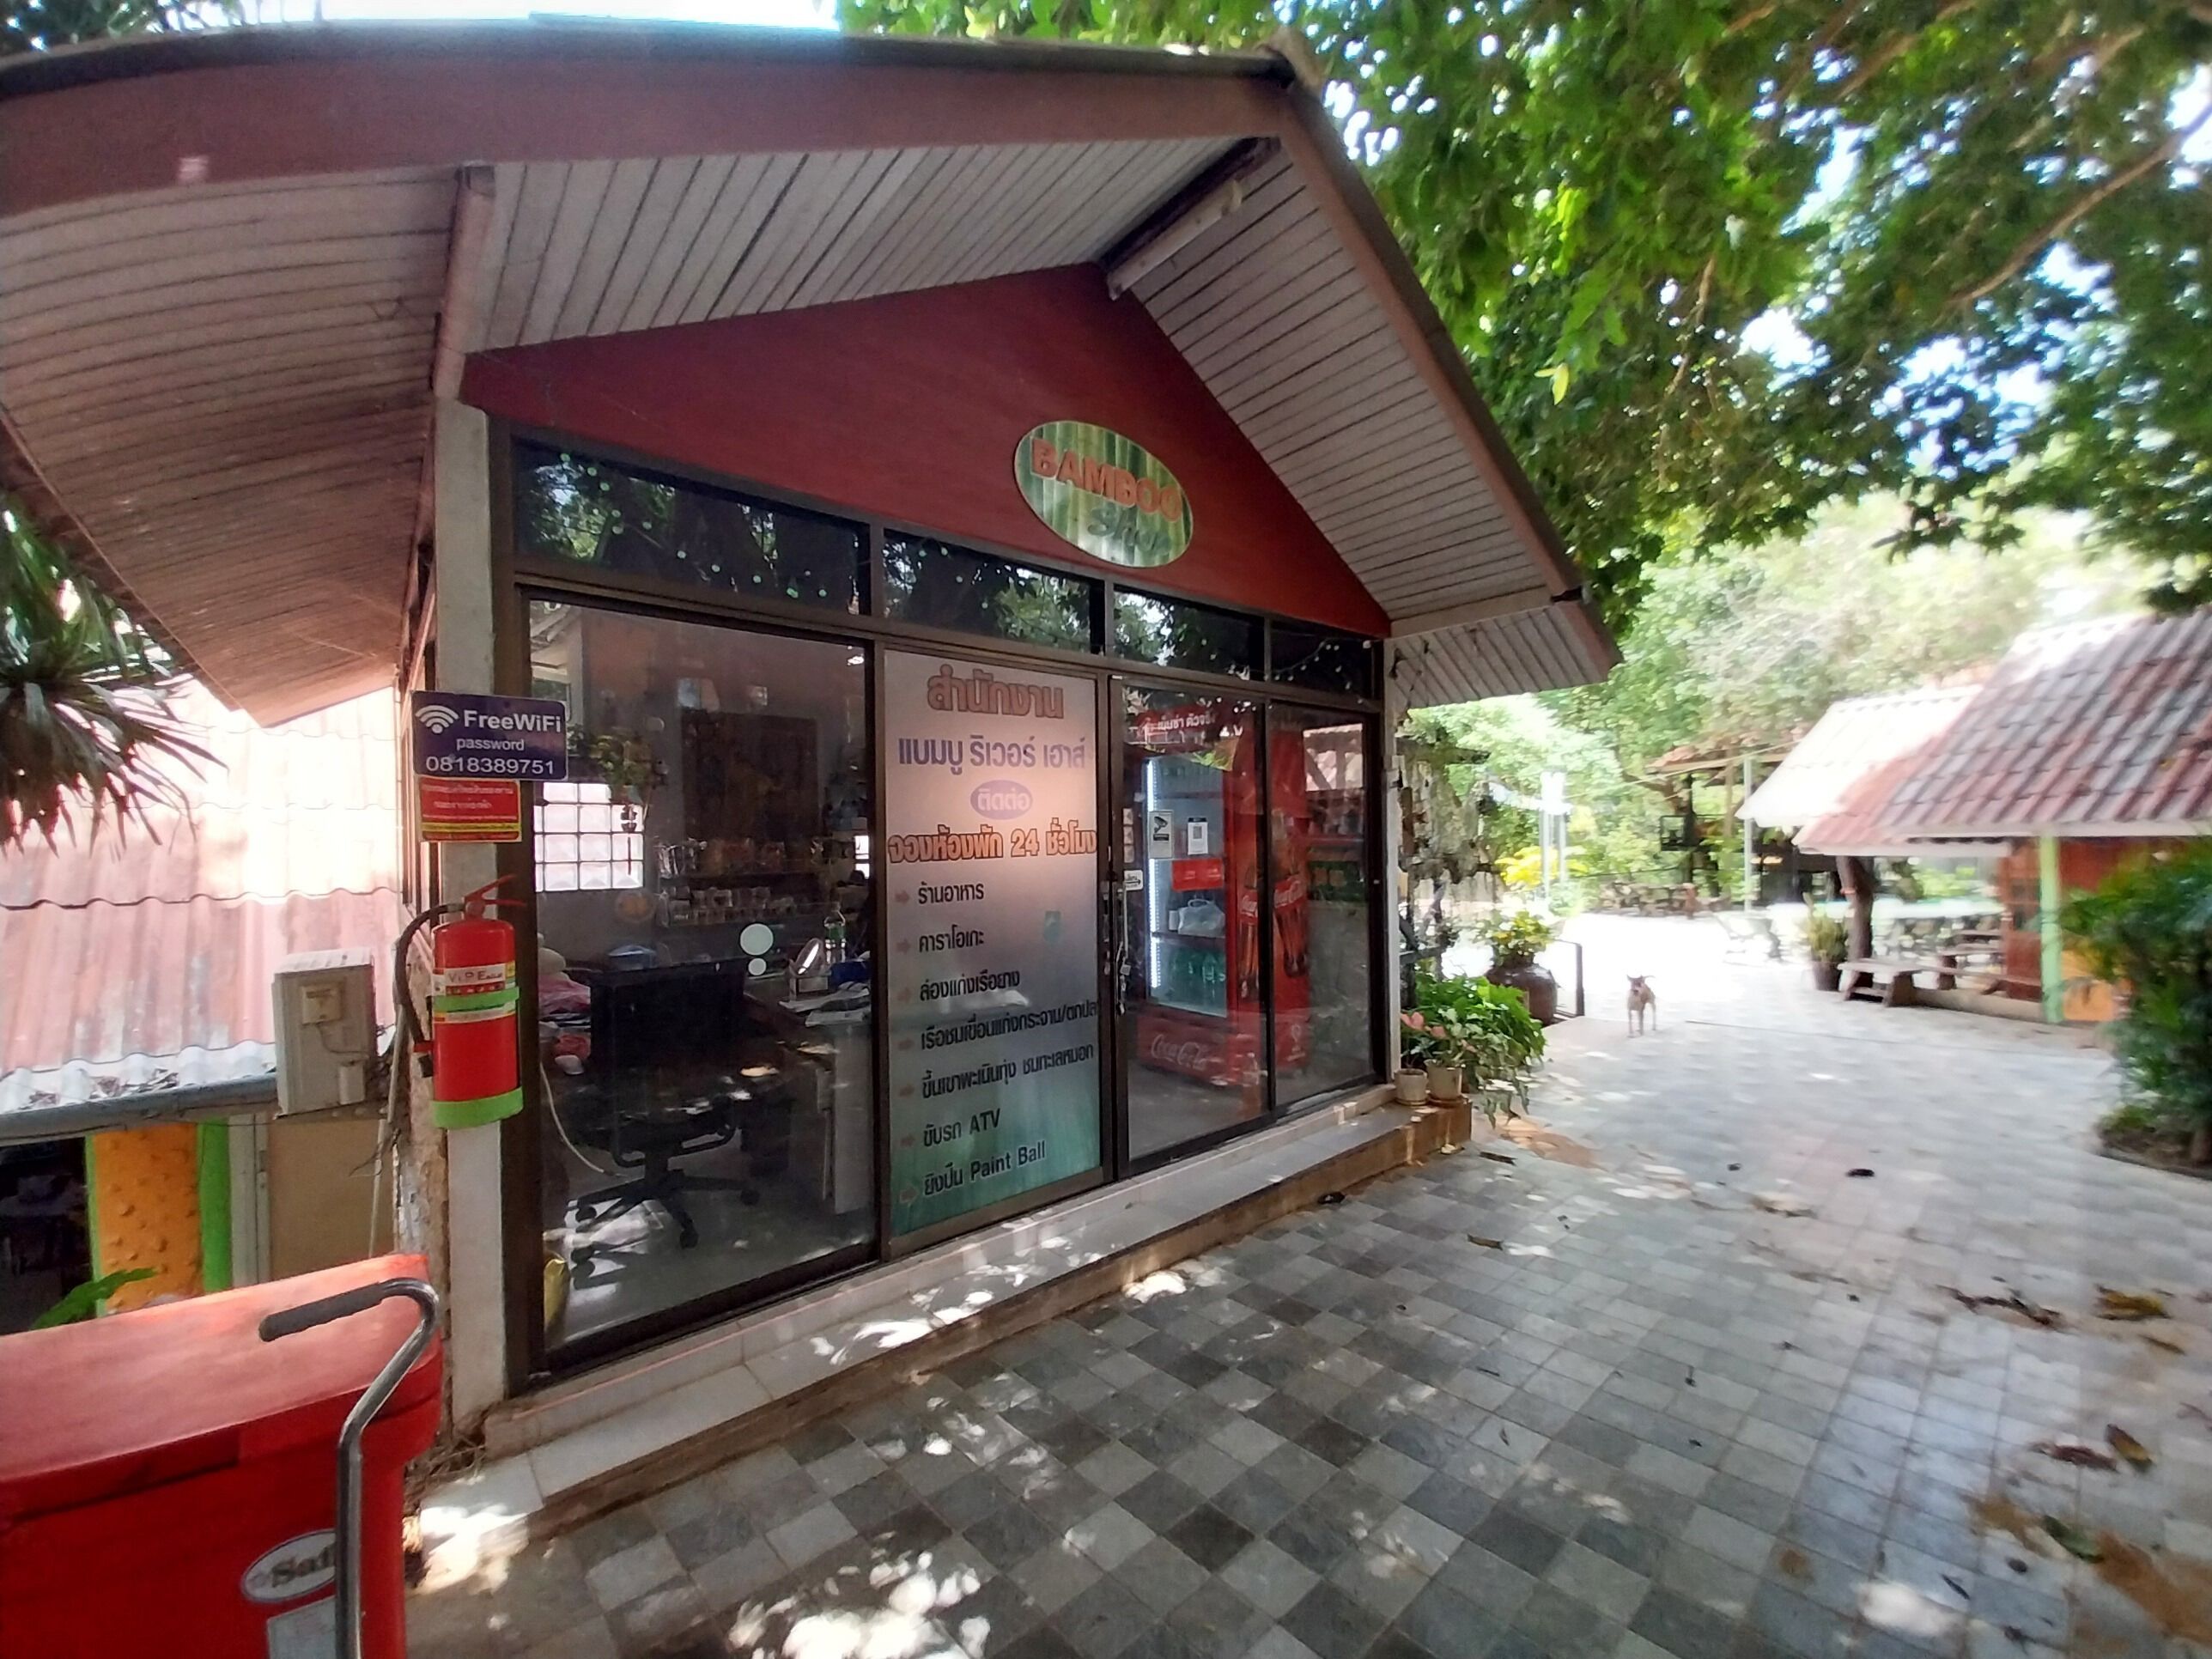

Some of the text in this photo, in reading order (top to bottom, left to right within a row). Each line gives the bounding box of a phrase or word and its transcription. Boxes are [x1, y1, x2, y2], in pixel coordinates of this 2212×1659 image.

[1030, 436, 1182, 523] BAMBOO
[927, 663, 1064, 719] สำนักงาน
[464, 710, 561, 732] FreeWiFi
[456, 738, 525, 751] password
[899, 734, 1085, 775] แบมบู ริเวอร์ เฮาส์
[425, 756, 554, 775] 0818389751
[977, 787, 1030, 811] ติดต่อ
[888, 817, 1097, 863] จองห้องพัก 24 ชั่วโมง
[918, 882, 984, 904] ร้านอาหาร
[919, 924, 984, 953] คาราโอเกะ
[920, 969, 1021, 1001] ล่องแก่งเรือยาง
[1023, 1043, 1094, 1075] ชมทะเลหมอก
[923, 1108, 1000, 1147] ขับรถ ATV
[924, 1140, 1045, 1195] ยิงปืน Paint Ball
